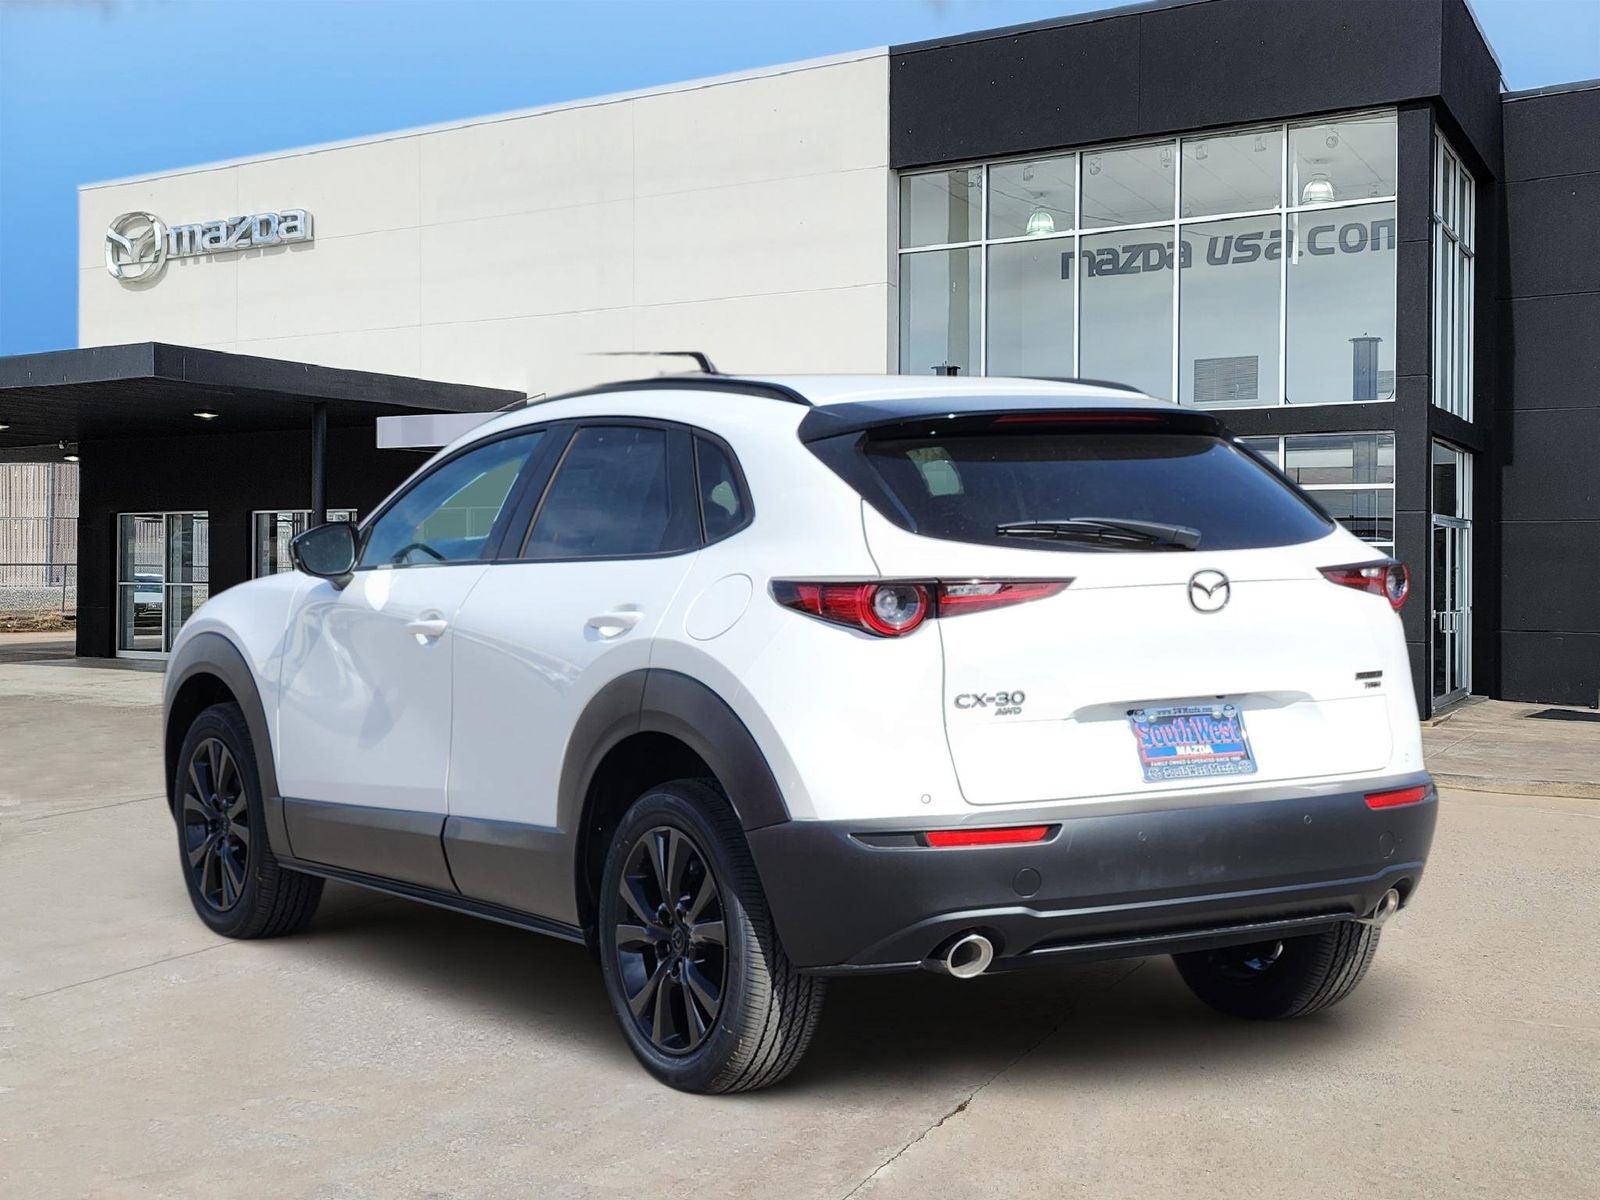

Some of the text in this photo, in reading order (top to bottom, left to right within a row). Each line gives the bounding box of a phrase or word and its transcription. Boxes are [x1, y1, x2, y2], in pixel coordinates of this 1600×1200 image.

[168, 209, 312, 256] mazda
[1061, 240, 1192, 280] mazda
[954, 690, 1026, 709] CX-30
[994, 706, 1022, 716] AWD
[1176, 743, 1214, 755] MAZDA
